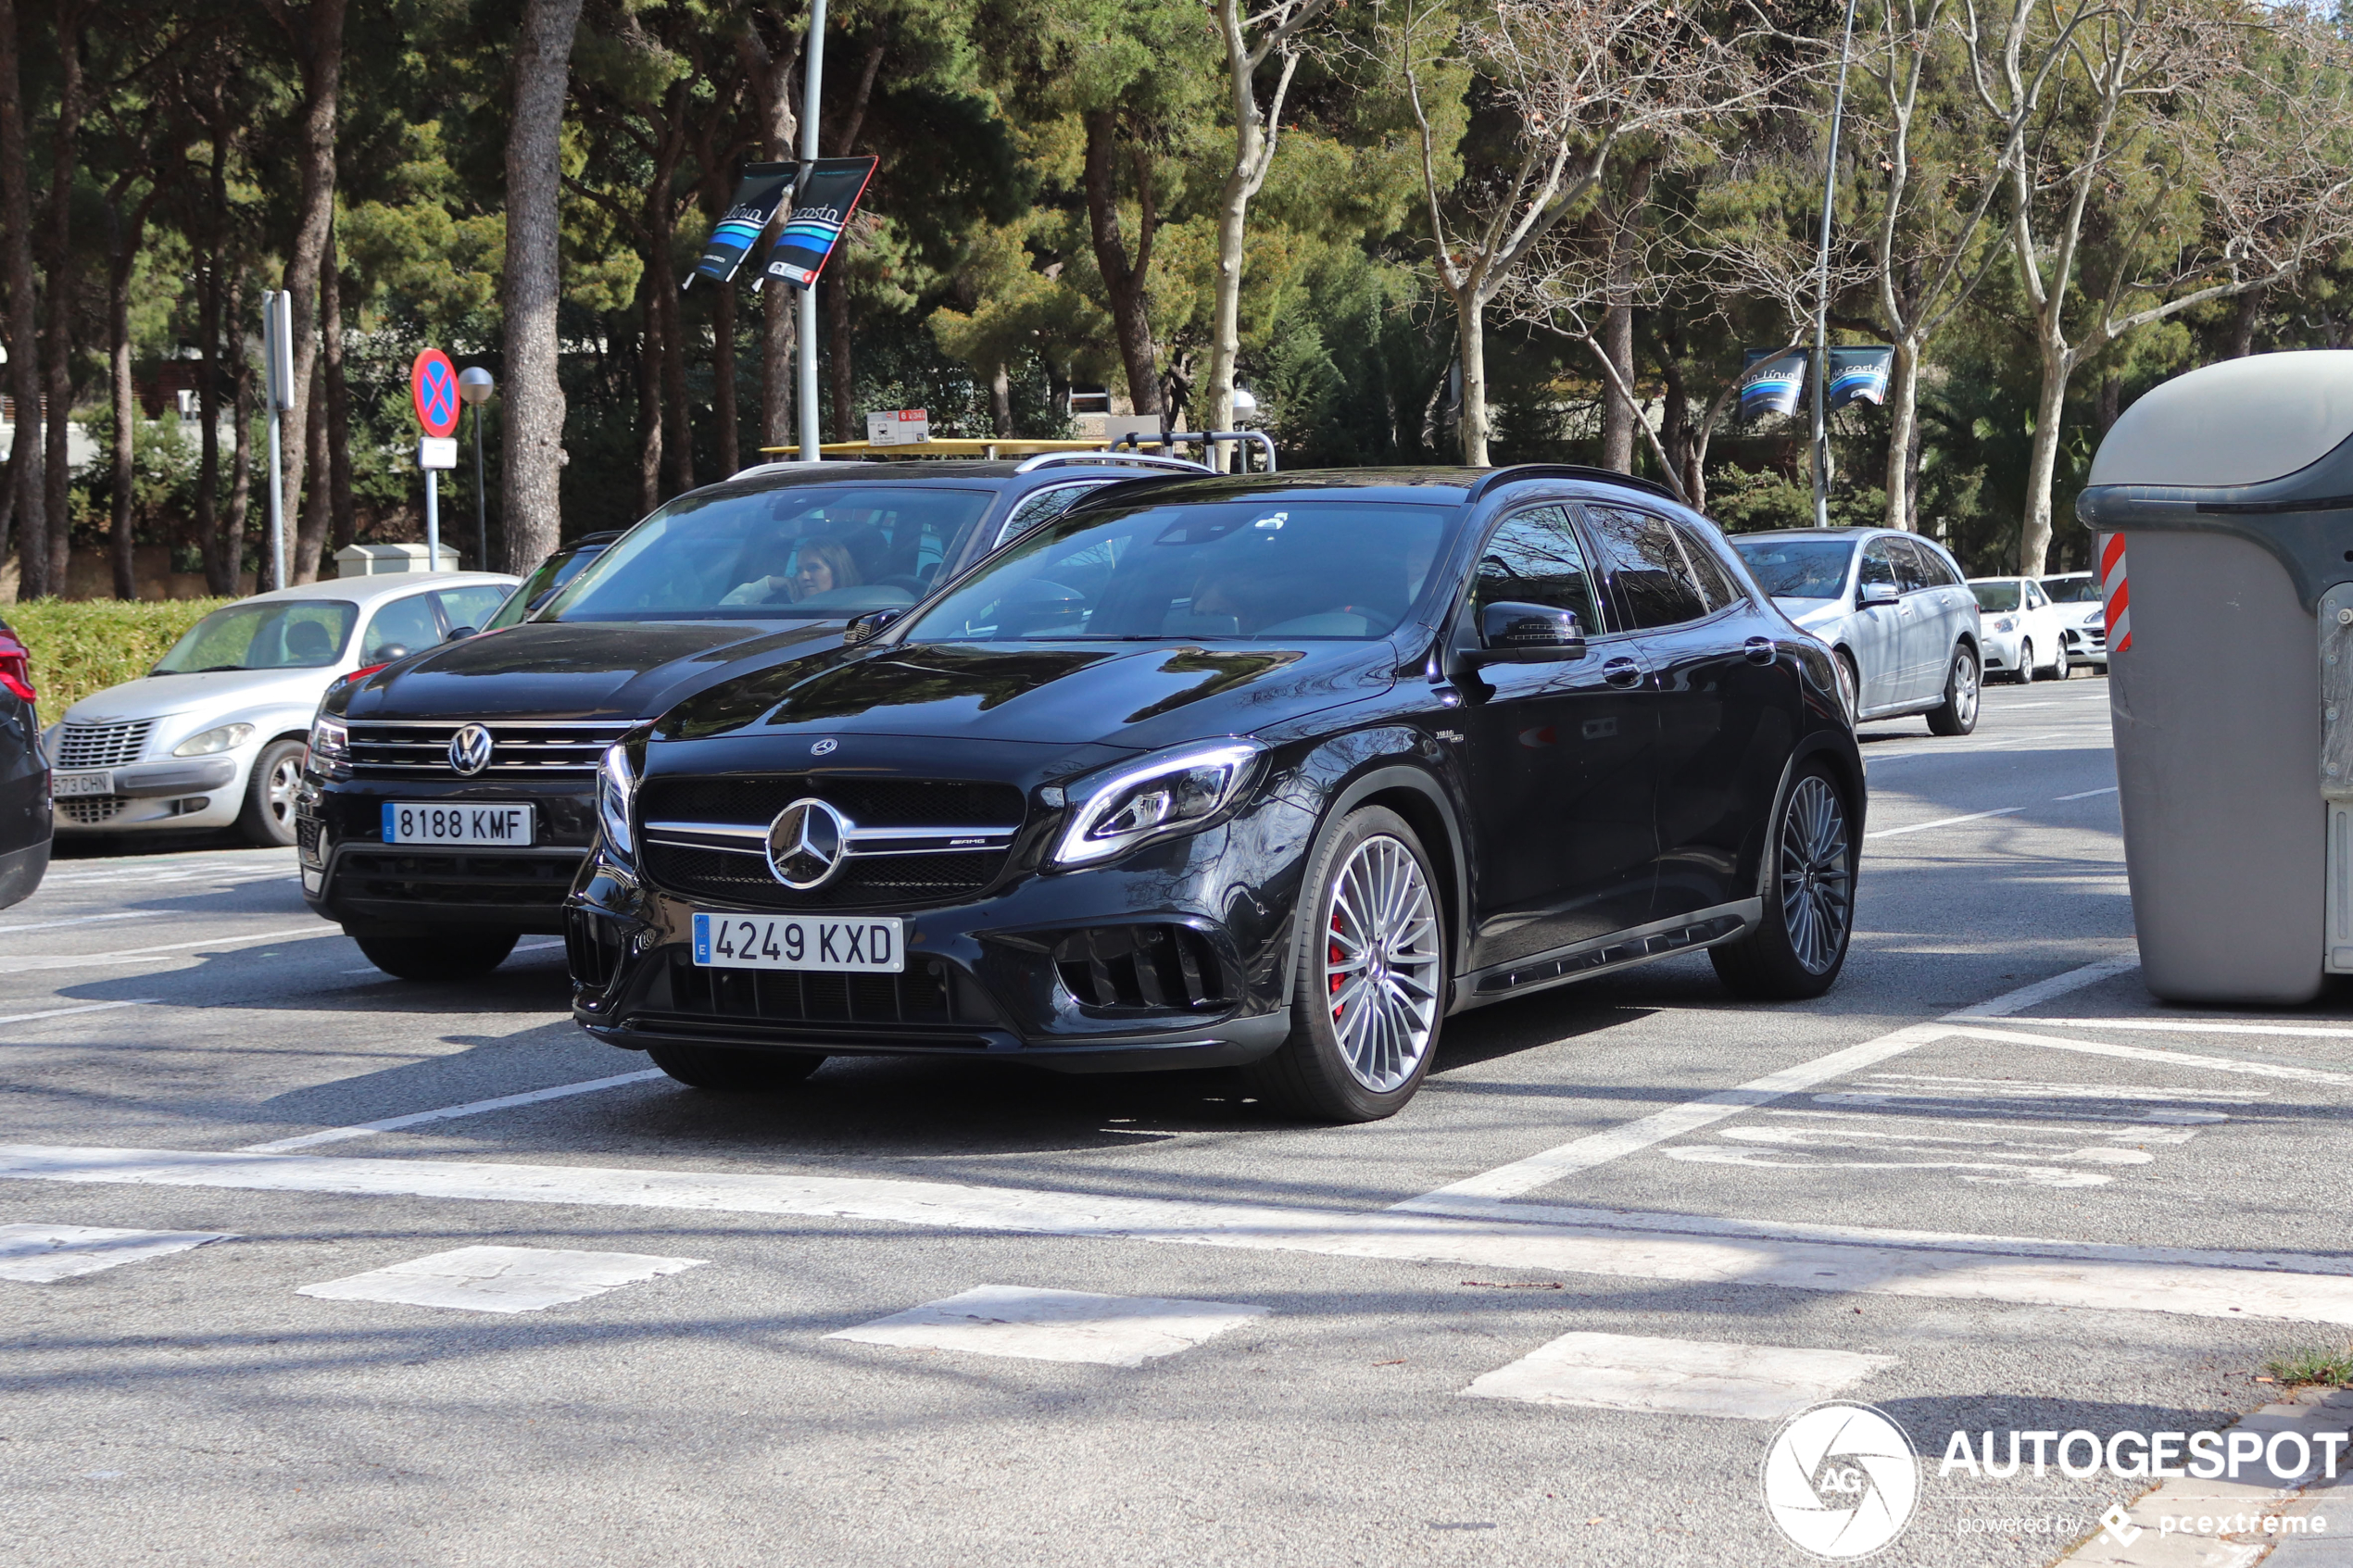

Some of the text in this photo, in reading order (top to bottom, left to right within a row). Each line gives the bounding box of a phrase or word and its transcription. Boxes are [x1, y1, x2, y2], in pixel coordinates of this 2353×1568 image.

[81, 775, 107, 794] CHN
[400, 809, 521, 839] 8188 KMF
[698, 944, 707, 956] E
[716, 920, 891, 964] 4249 KXD
